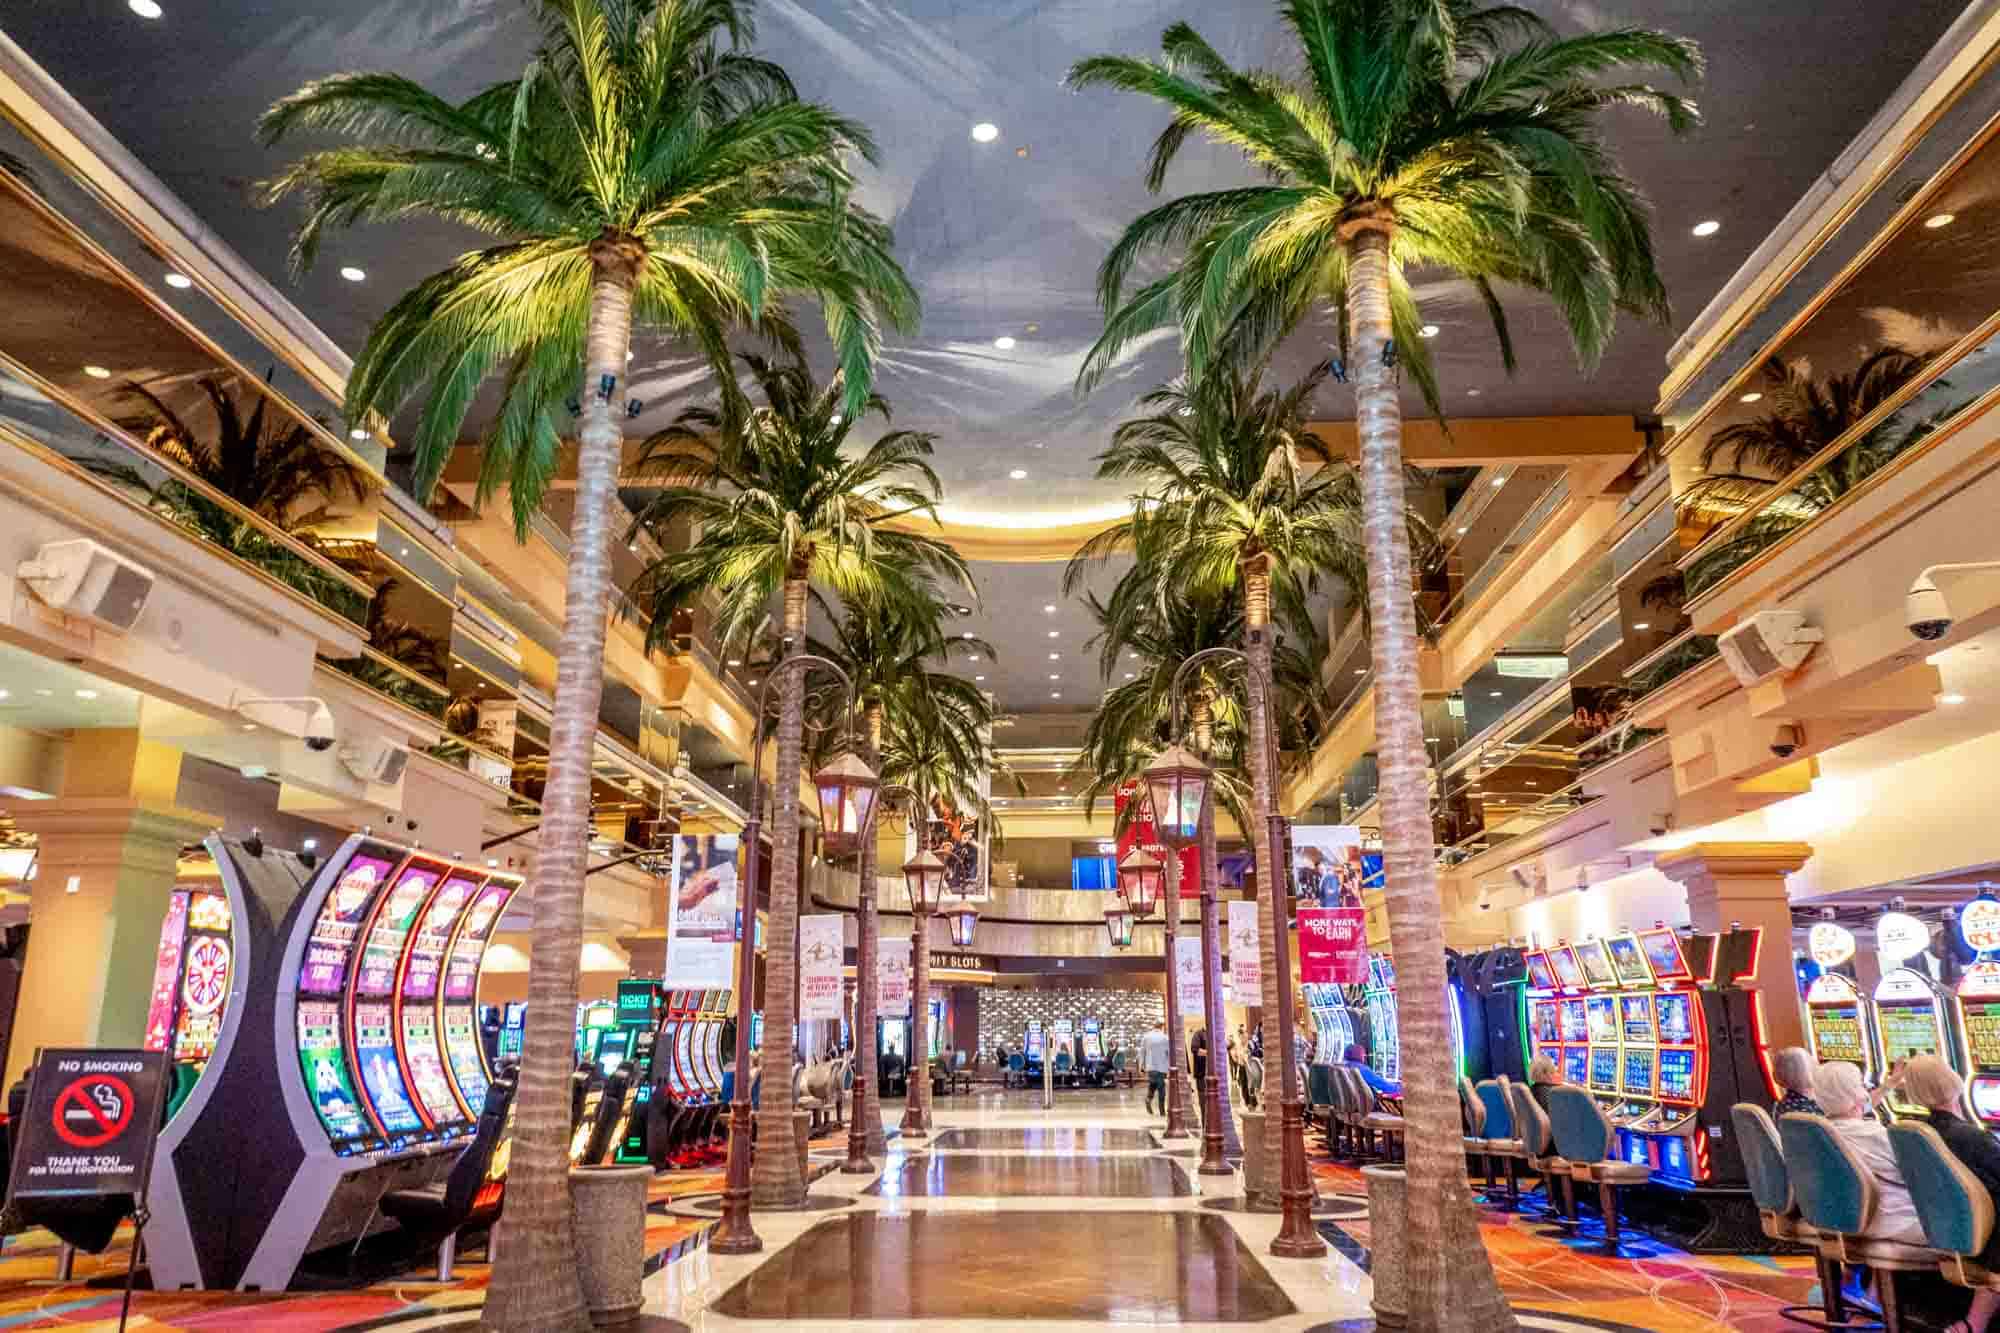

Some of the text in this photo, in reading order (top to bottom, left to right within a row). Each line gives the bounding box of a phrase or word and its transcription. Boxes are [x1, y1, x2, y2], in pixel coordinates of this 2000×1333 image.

[1304, 918, 1358, 928] MORE WAYS
[1312, 926, 1352, 941] TO EARN
[621, 994, 650, 1005] TICKET
[58, 1060, 143, 1073] NO SMOKING
[47, 1155, 120, 1167] THANK YOU
[28, 1164, 135, 1175] FOR YOUR COOPERATION
